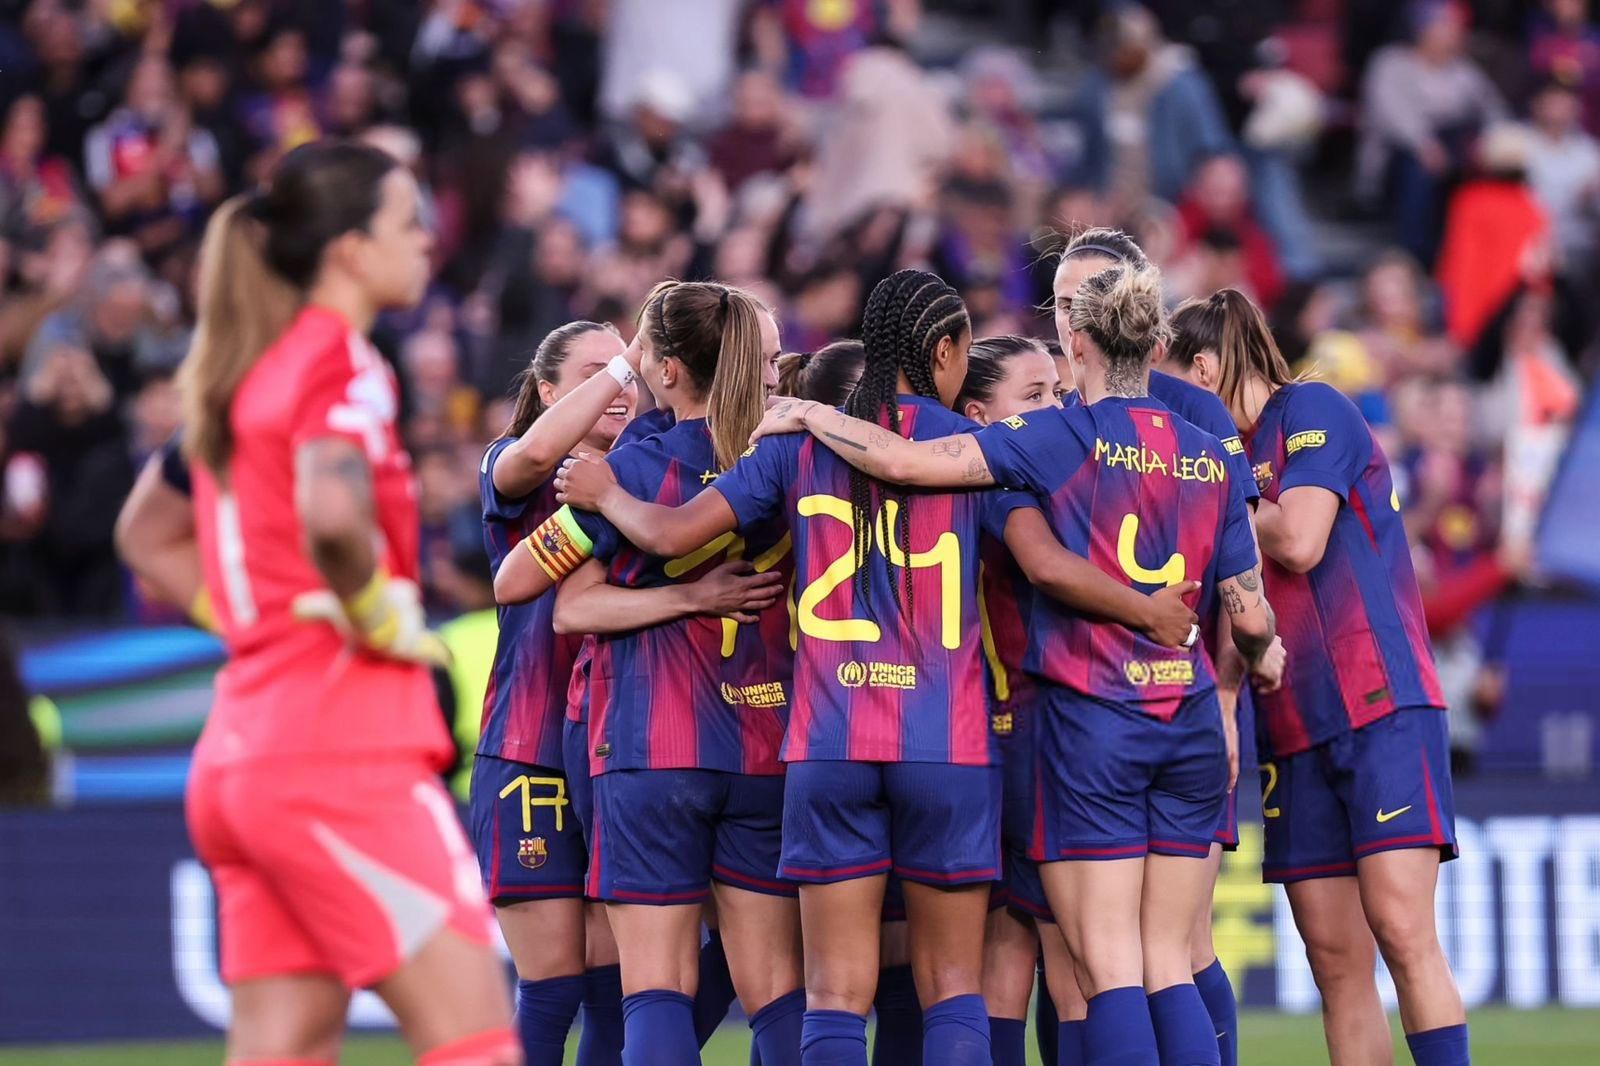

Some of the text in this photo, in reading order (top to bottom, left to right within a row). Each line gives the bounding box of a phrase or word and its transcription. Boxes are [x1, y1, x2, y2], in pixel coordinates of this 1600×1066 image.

[1286, 432, 1327, 453] BIMBO
[1094, 437, 1226, 484] MARÍA LEÓN
[797, 494, 961, 650] 24
[869, 661, 916, 676] UNHCR
[869, 672, 916, 685] ACNUR
[740, 681, 783, 696] UNHCR
[499, 774, 569, 833] 17
